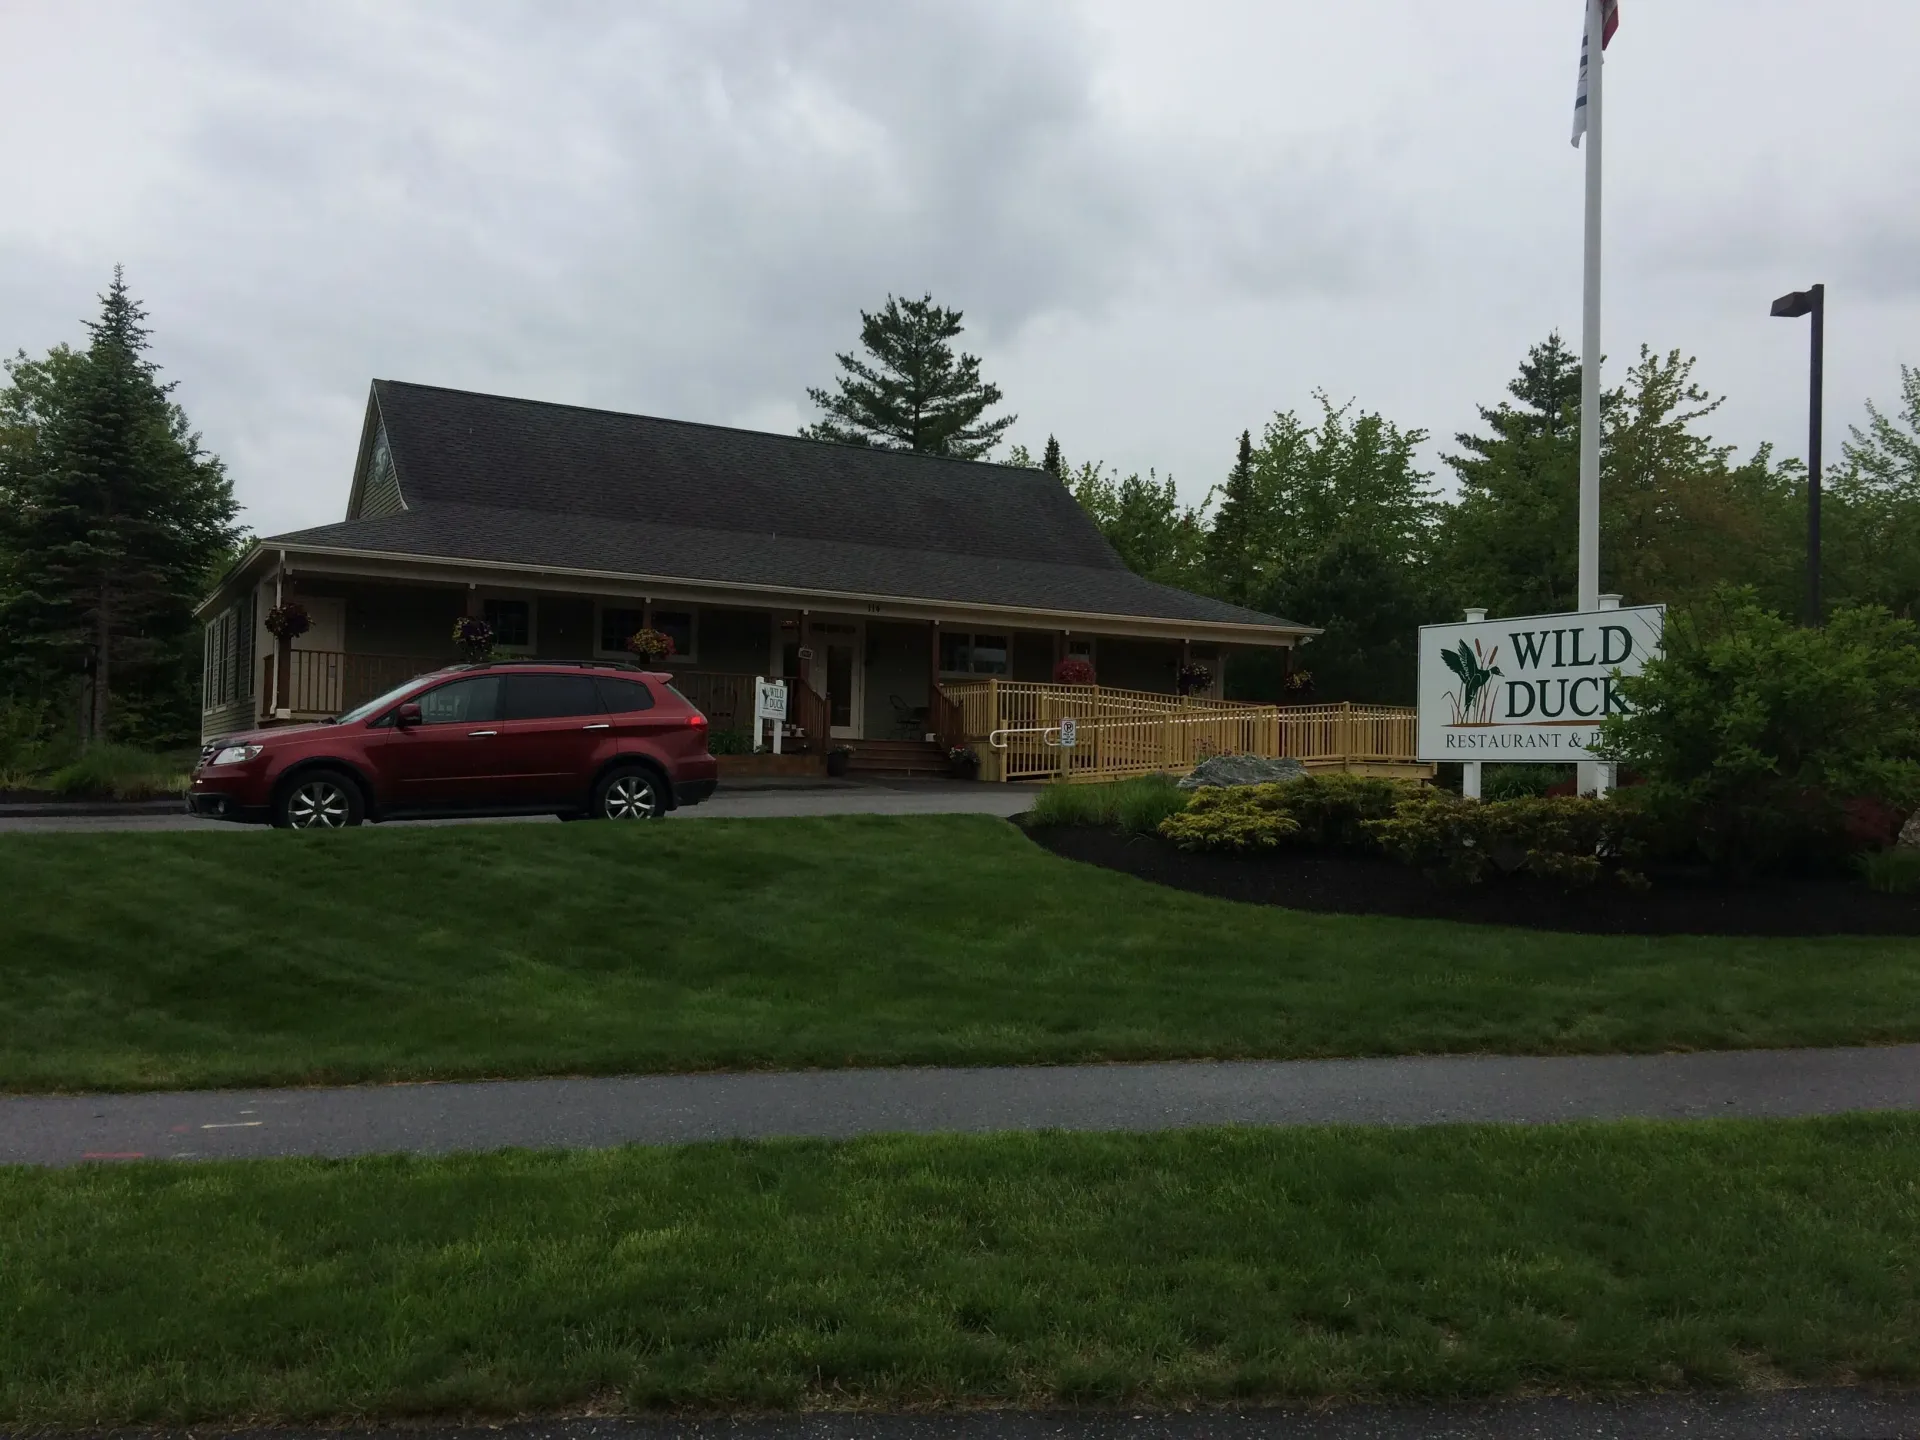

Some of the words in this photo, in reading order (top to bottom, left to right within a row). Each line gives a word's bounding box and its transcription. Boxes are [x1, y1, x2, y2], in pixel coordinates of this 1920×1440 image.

[1508, 625, 1632, 669] WILD
[770, 687, 784, 698] WILD
[1505, 677, 1638, 718] DUCK
[769, 698, 784, 709] DUCK
[1445, 733, 1562, 748] RESTAURANT
[1568, 732, 1582, 748] &
